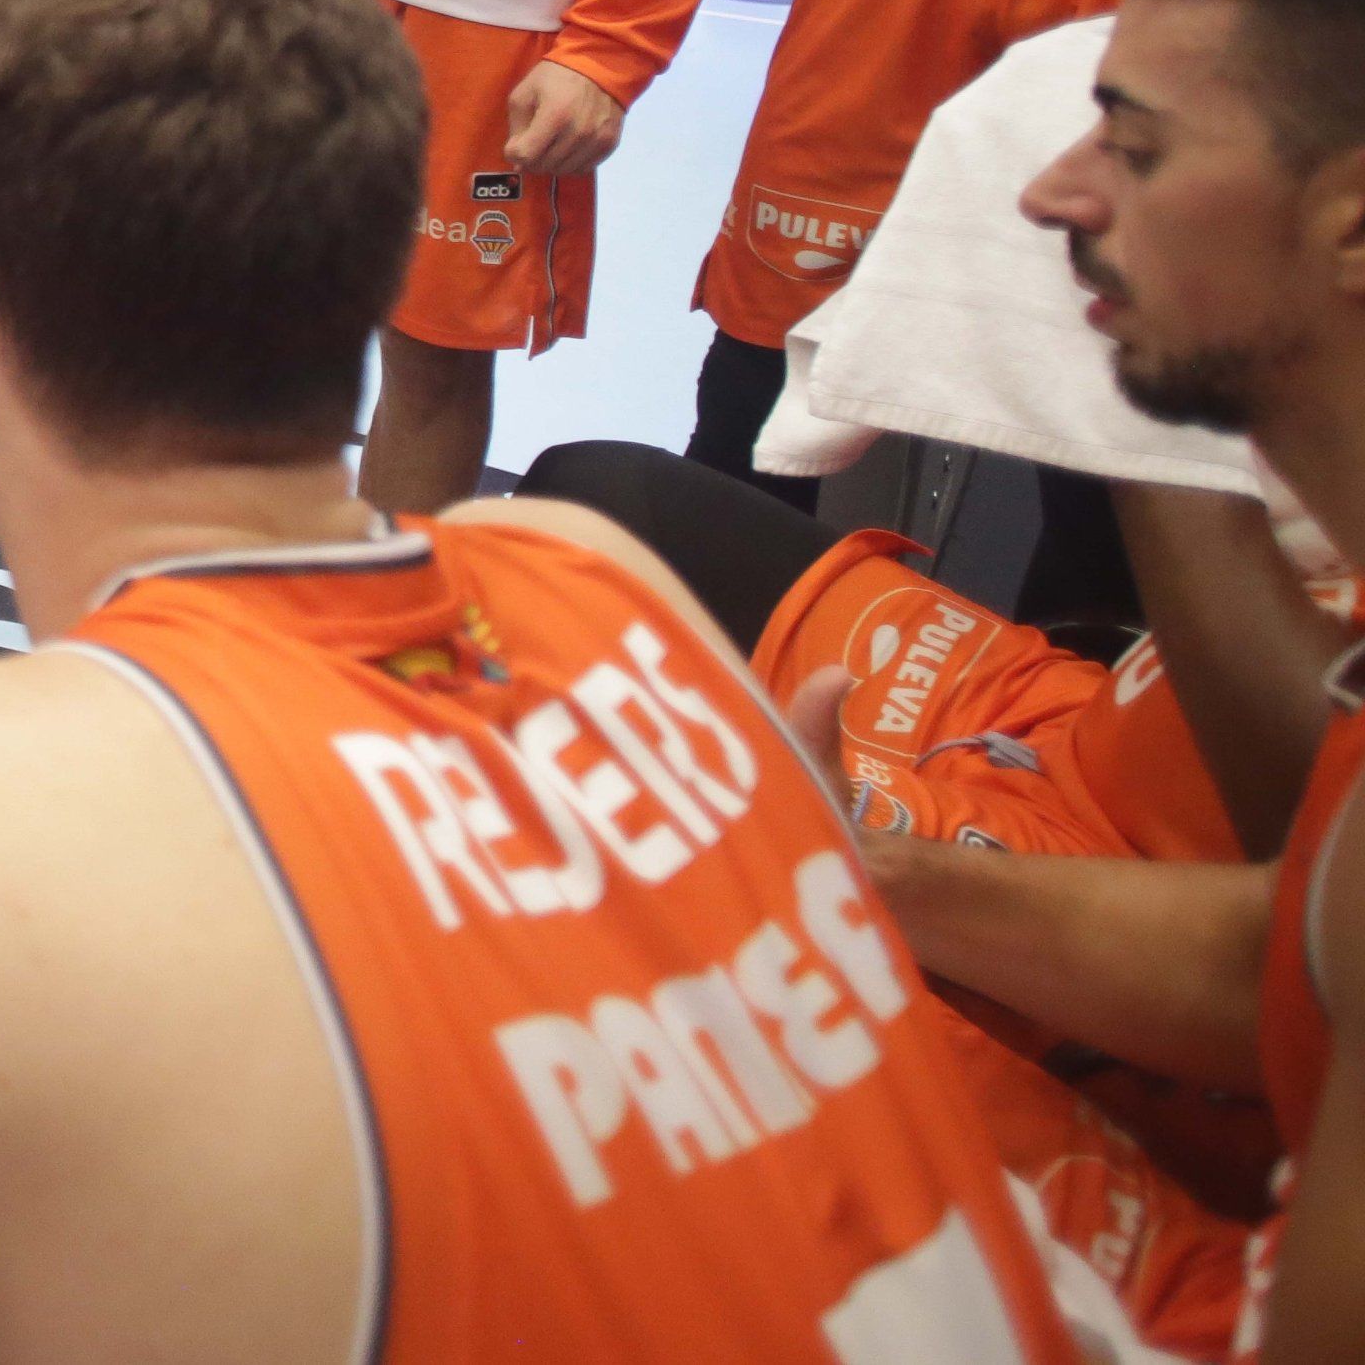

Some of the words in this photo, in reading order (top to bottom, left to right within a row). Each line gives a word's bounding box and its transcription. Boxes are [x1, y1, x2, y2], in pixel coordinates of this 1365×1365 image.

[476, 184, 510, 197] acb
[756, 201, 875, 250] PULEV
[873, 603, 977, 733] PULEVA
